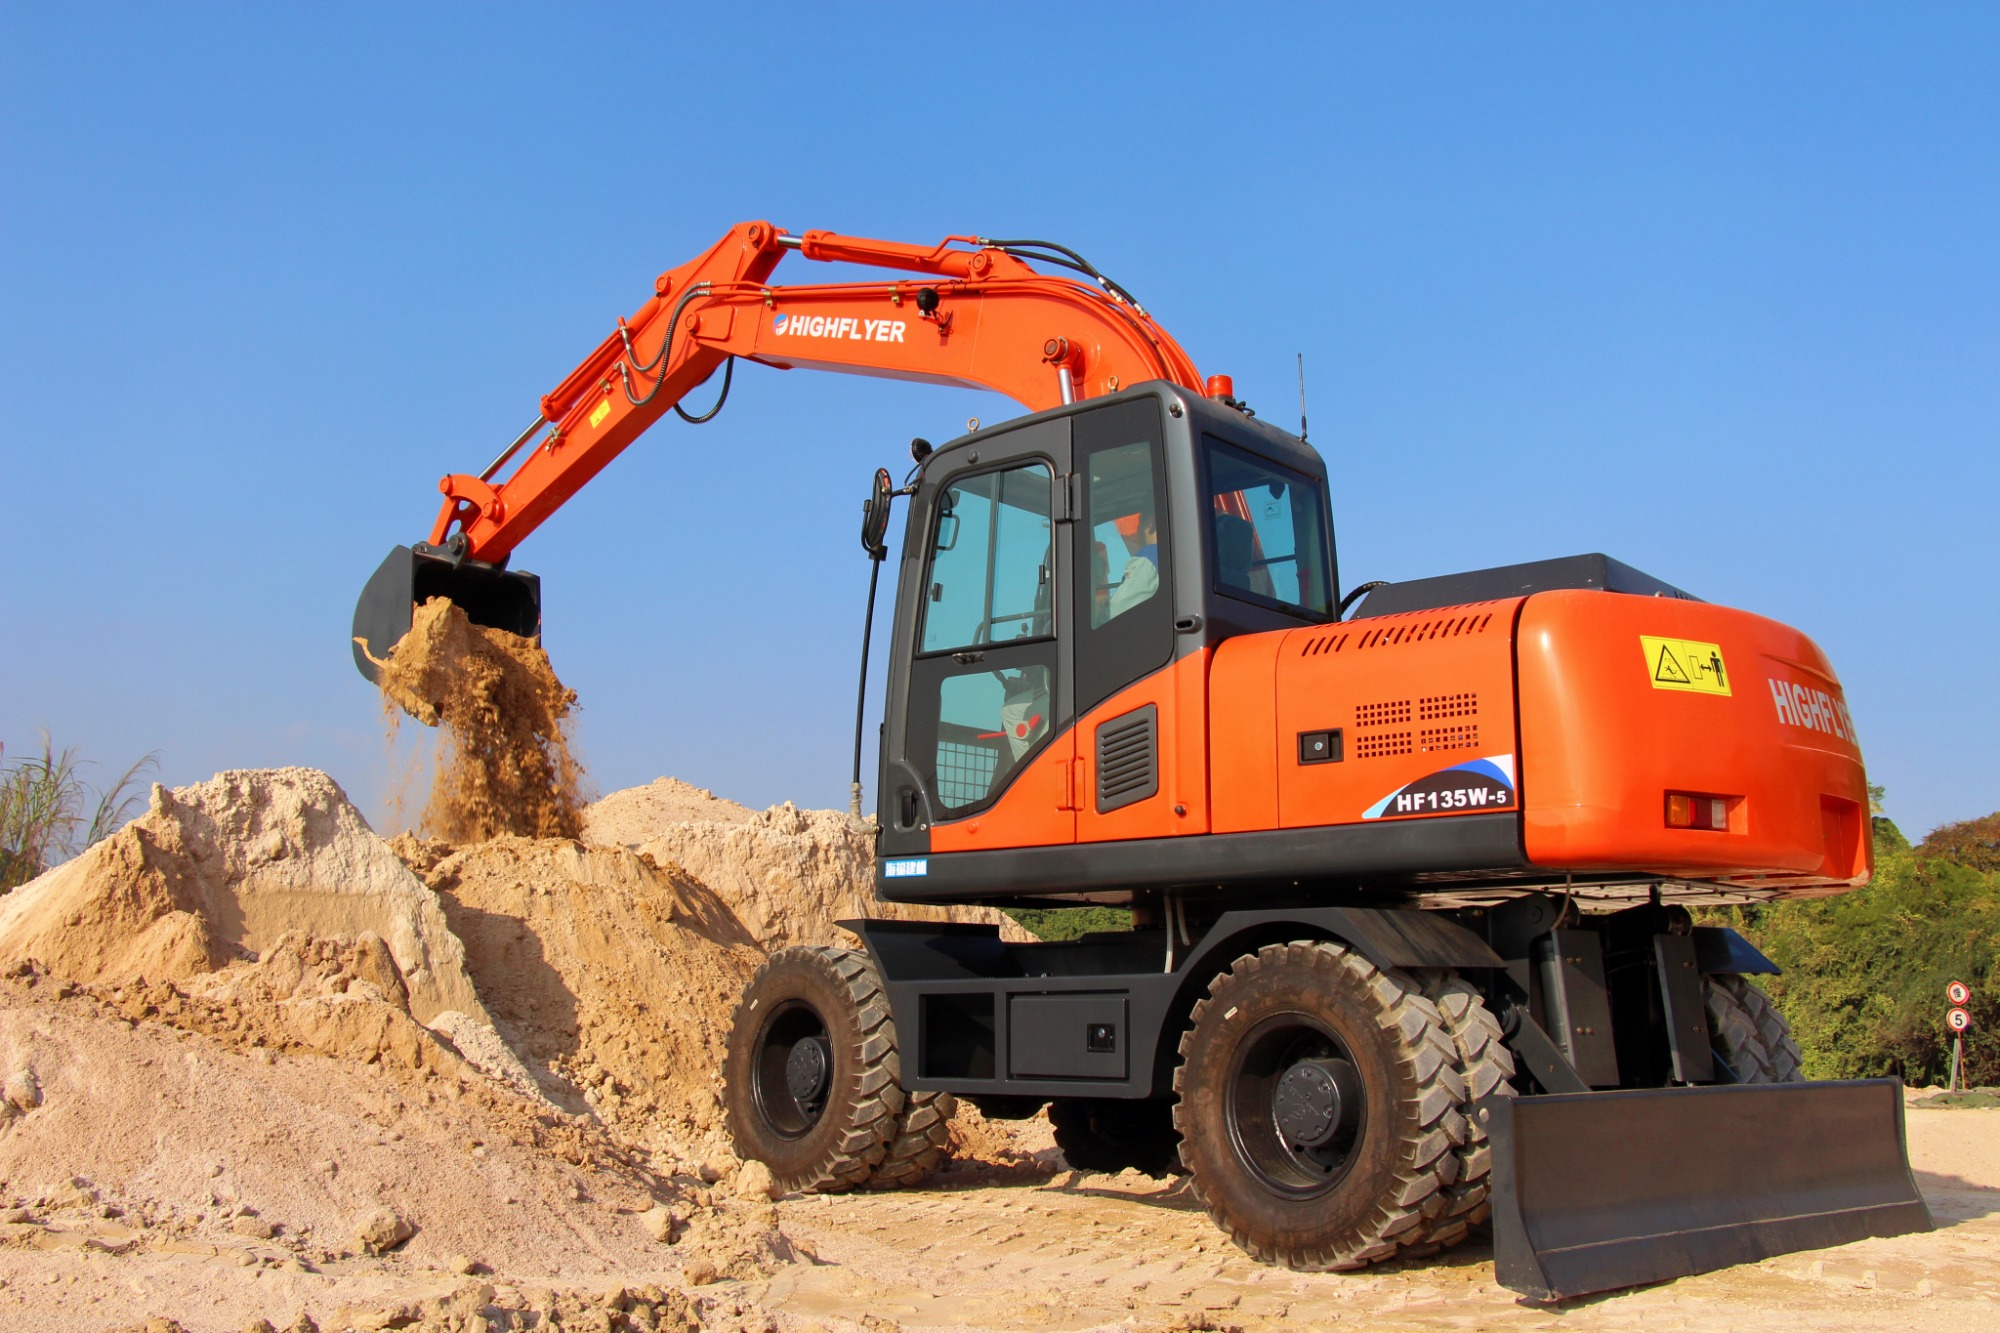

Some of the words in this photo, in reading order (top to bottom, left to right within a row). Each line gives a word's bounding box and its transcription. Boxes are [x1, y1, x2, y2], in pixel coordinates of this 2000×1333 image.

[788, 315, 906, 342] HIGHFLYER
[1397, 787, 1507, 812] HF135W-5
[1955, 1014, 1963, 1026] 5
